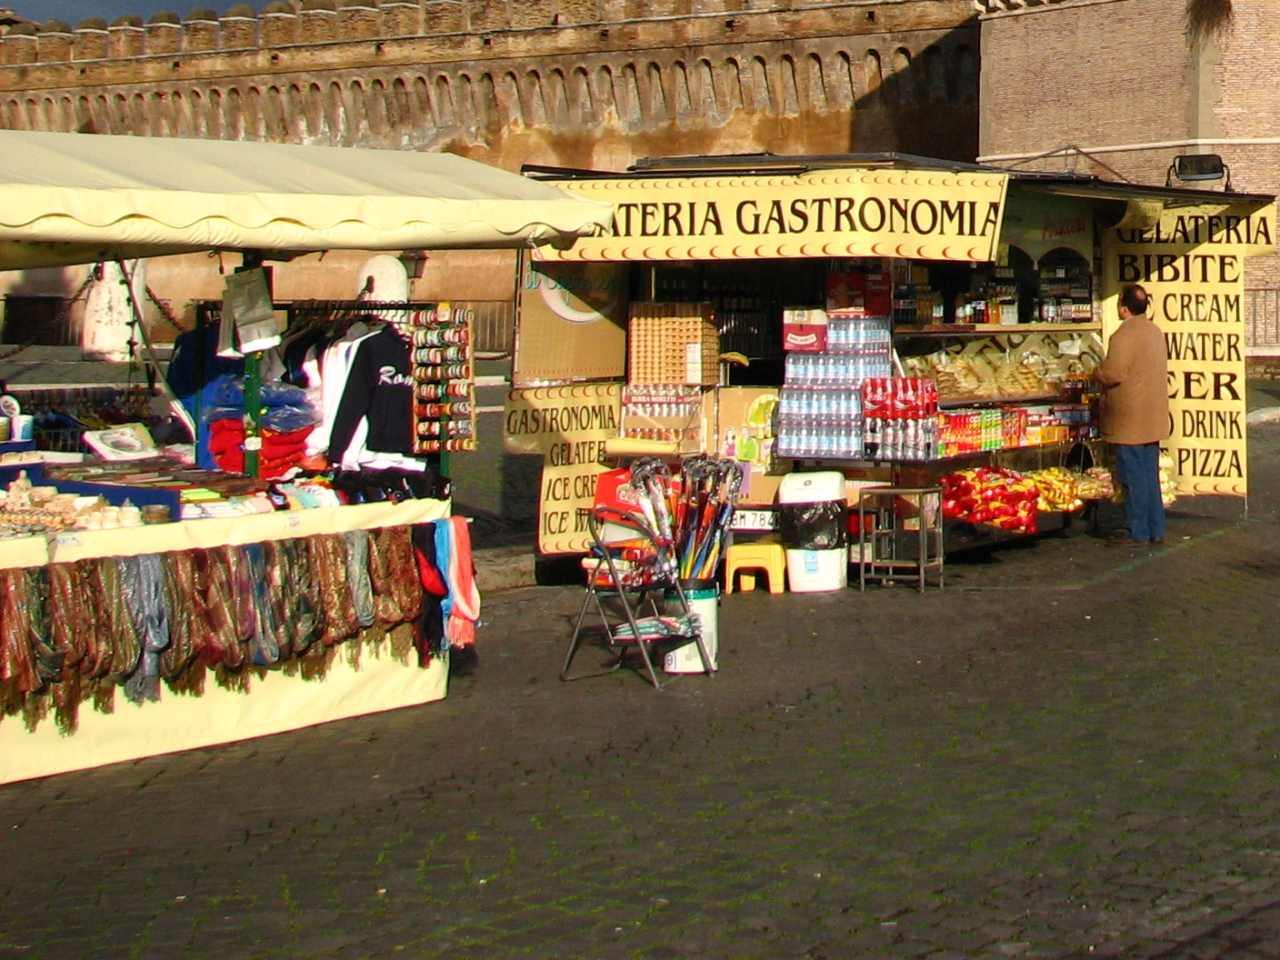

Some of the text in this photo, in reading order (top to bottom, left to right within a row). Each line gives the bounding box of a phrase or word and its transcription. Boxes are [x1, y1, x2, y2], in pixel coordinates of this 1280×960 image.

[735, 196, 1000, 237] GASTRONOMIA
[1117, 253, 1241, 283] BIBITE
[1162, 292, 1242, 323] CREAM
[1164, 332, 1242, 362] WATER
[507, 404, 617, 435] GASTRONOMIA
[1181, 409, 1243, 440] DRINK
[1177, 447, 1244, 478] PIZZA
[545, 476, 571, 502] ICE
[543, 511, 570, 536] ICE
